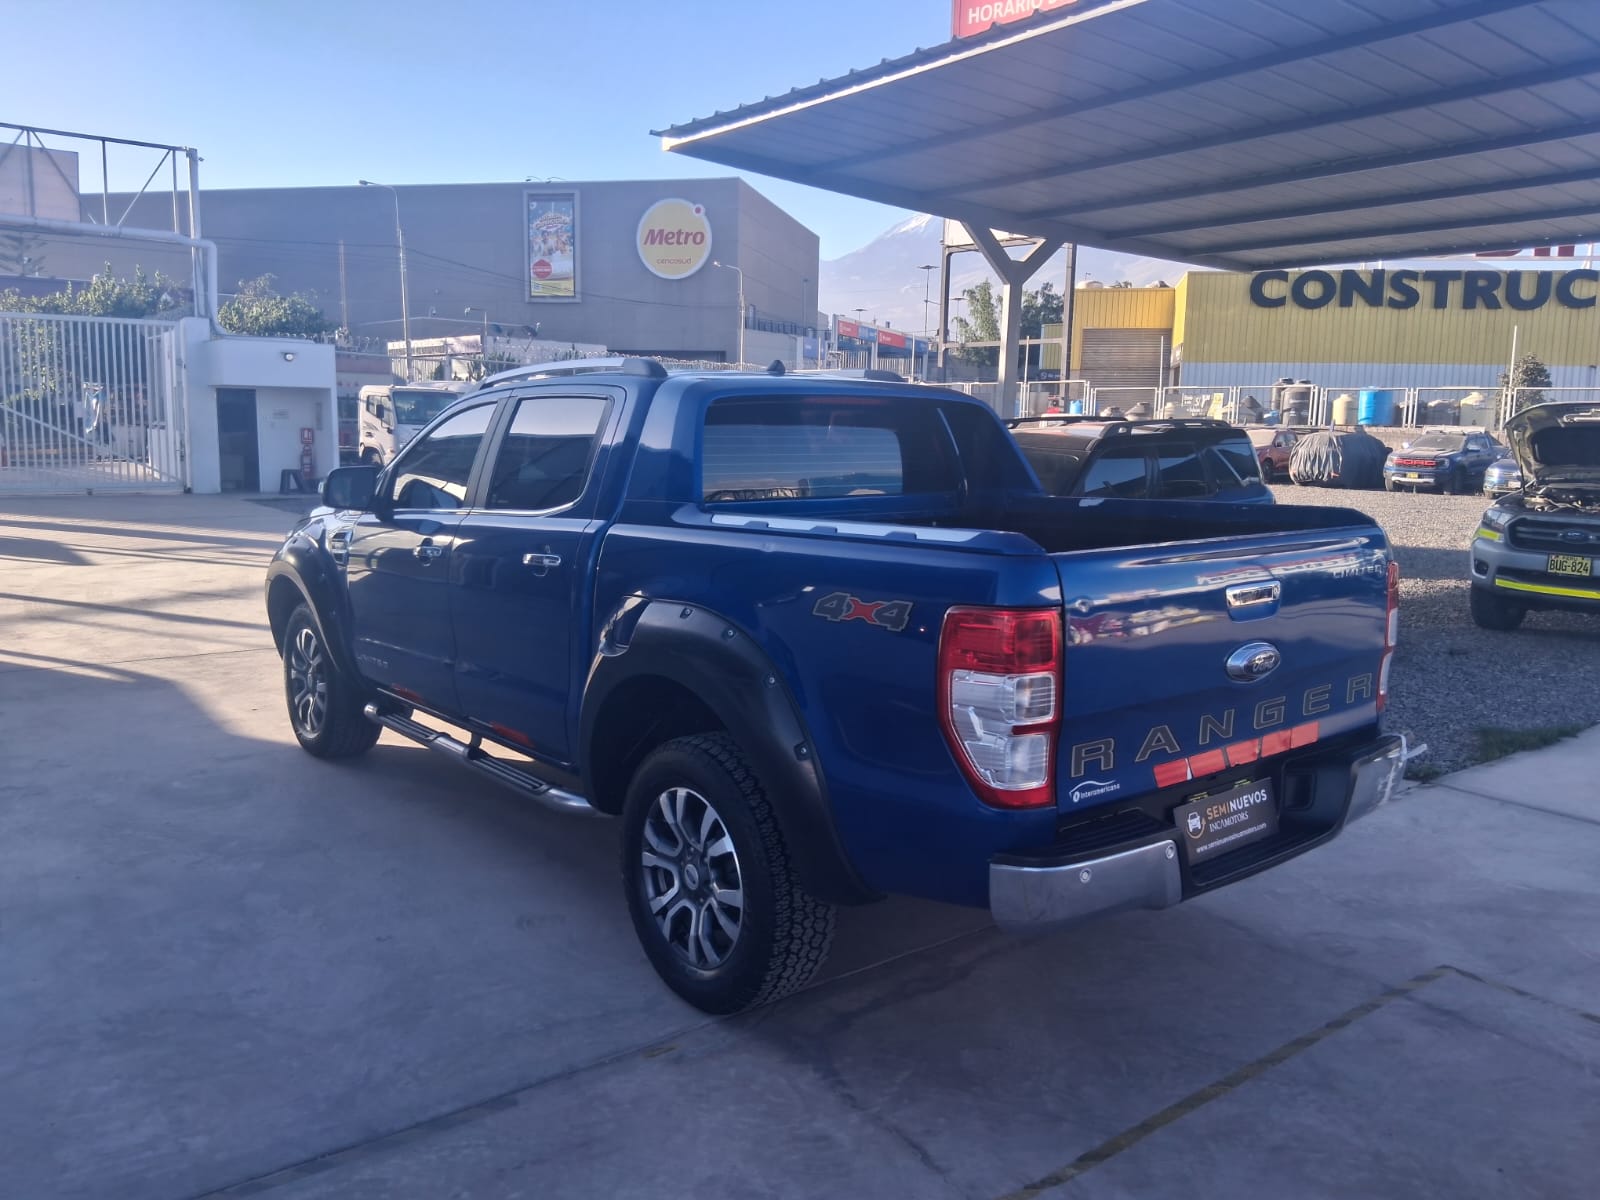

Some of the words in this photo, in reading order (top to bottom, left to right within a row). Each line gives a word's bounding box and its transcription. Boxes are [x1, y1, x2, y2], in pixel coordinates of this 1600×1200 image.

[643, 228, 705, 246] Metro
[1250, 268, 1599, 311] CONSTRUC
[1550, 559, 1590, 574] BUG-824
[1070, 672, 1374, 778] RANGER
[1206, 788, 1268, 820] SEMINUEVOS
[1208, 810, 1249, 833] INCAMOTORS
